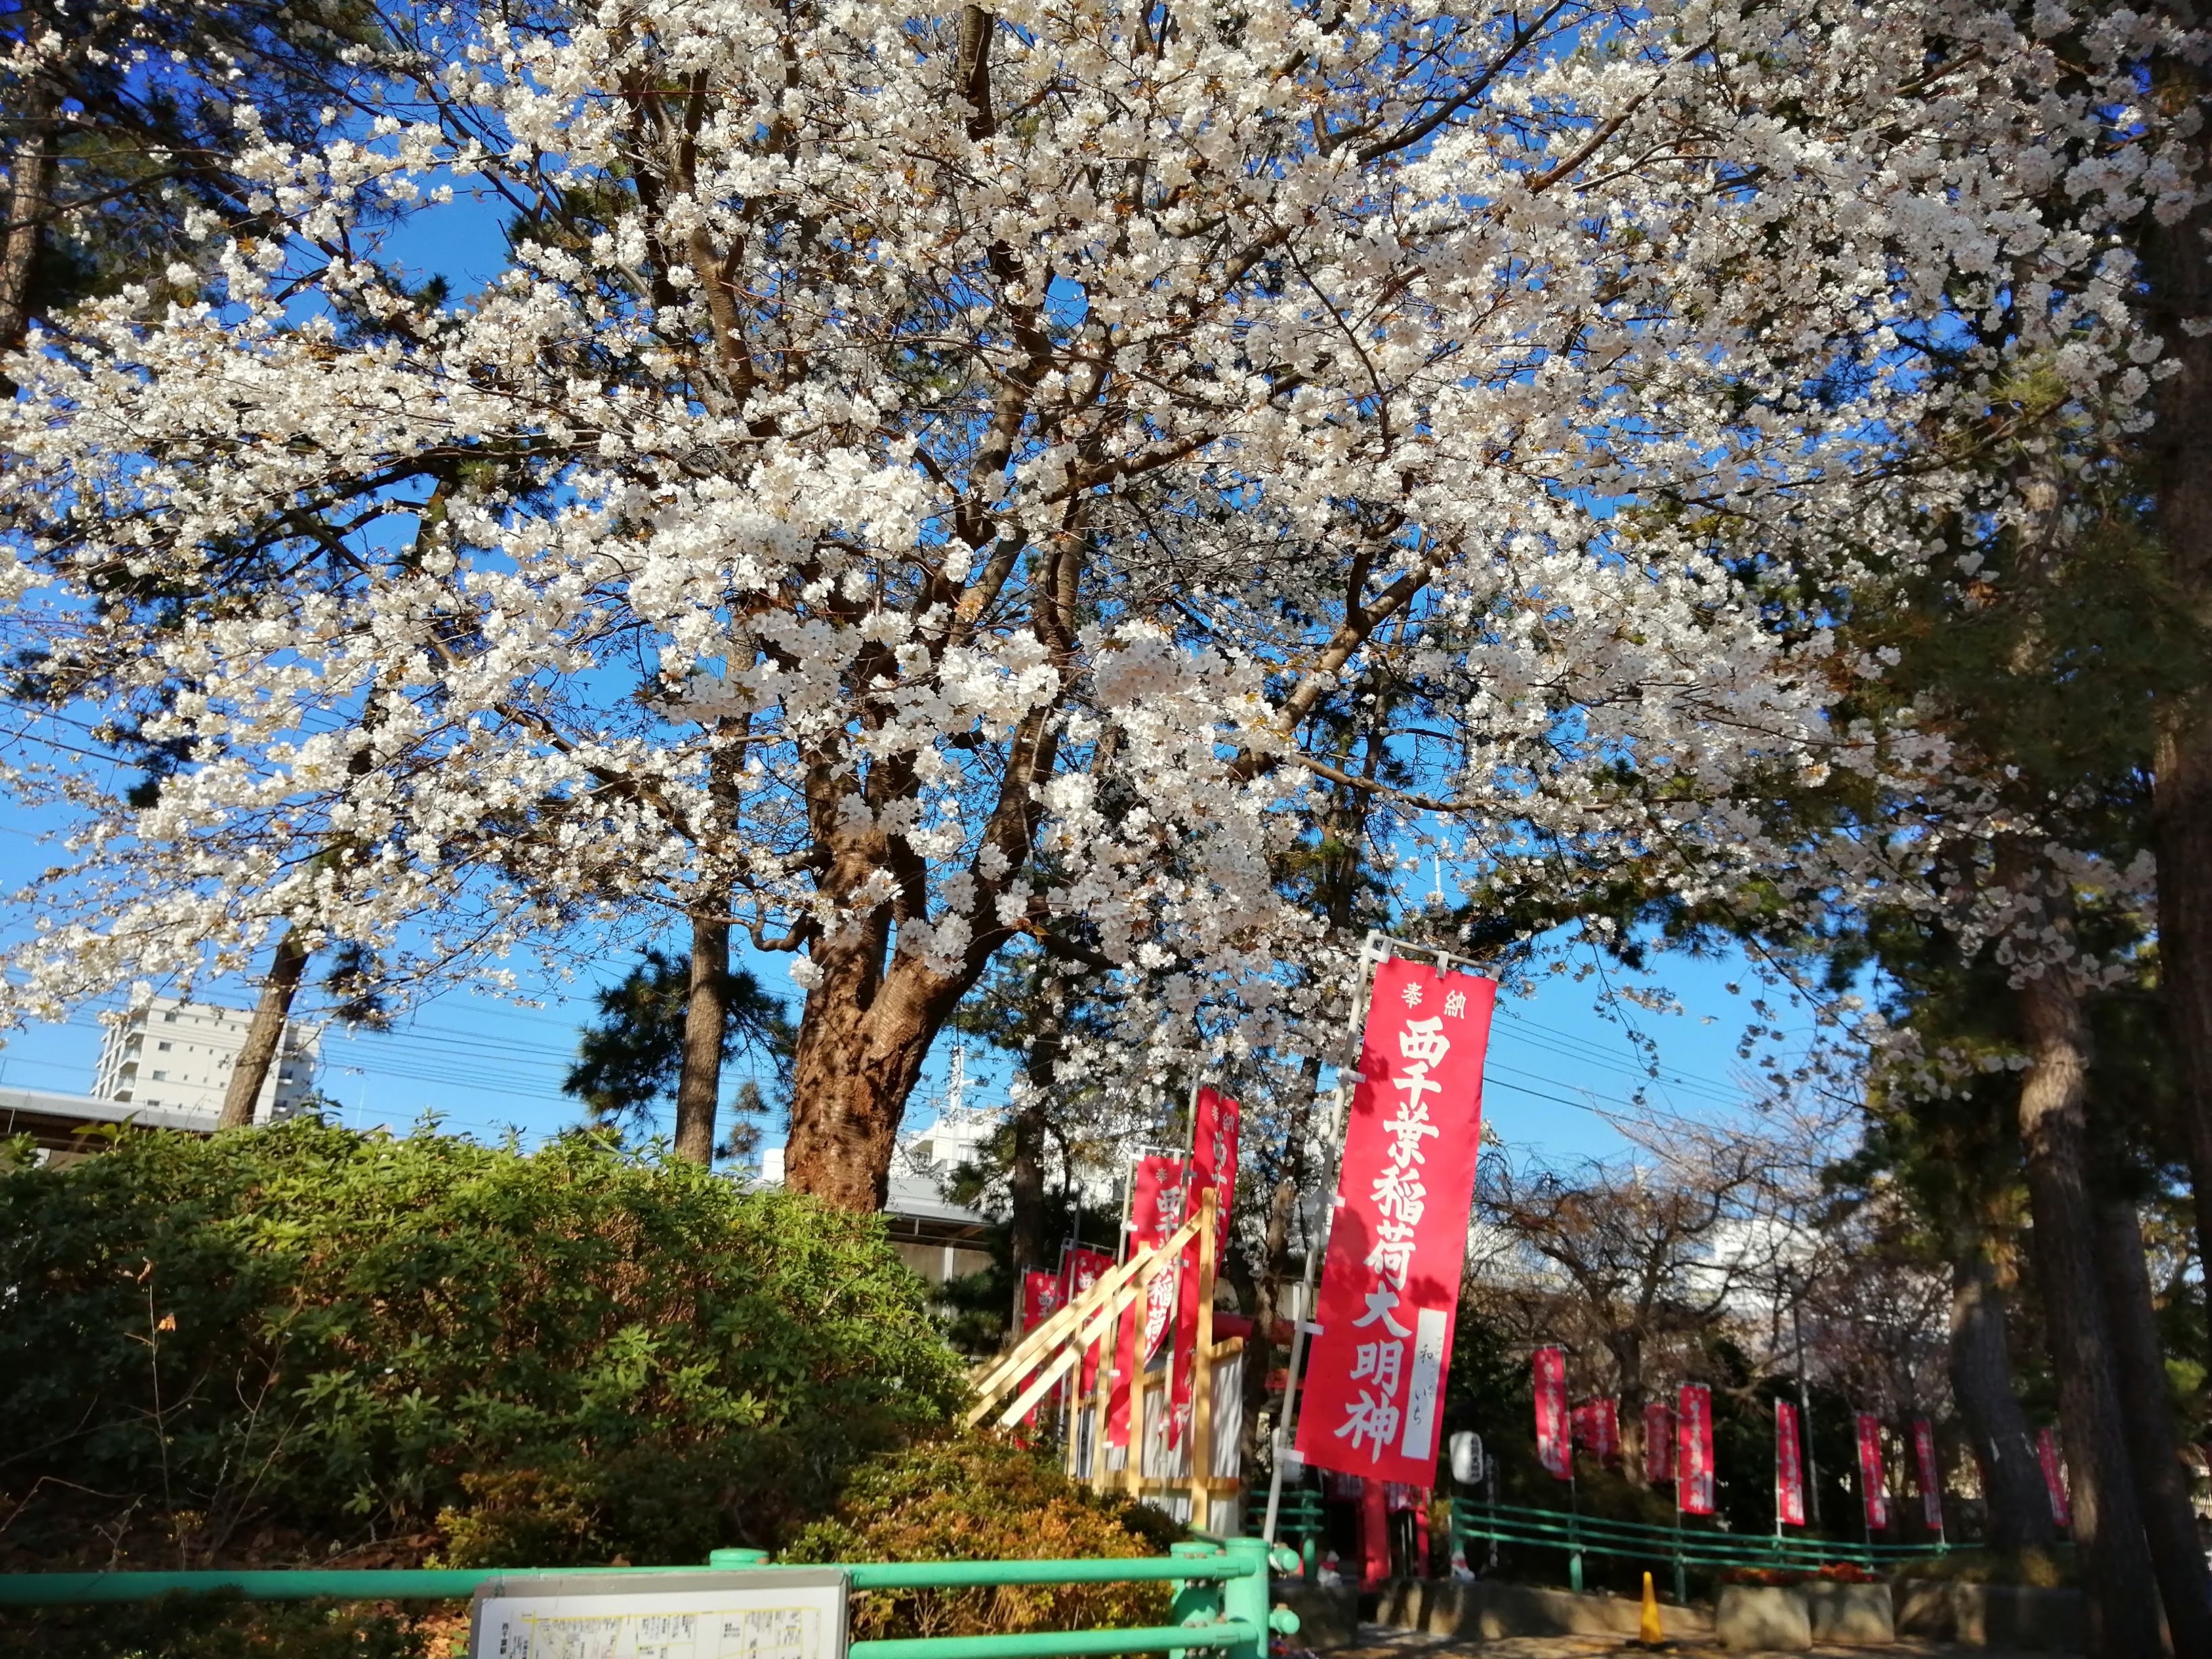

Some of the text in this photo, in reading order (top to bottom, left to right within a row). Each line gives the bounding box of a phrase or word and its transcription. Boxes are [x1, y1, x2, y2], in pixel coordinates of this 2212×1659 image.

[1333, 1016, 1451, 1464] 西千葉稲荷大明神
